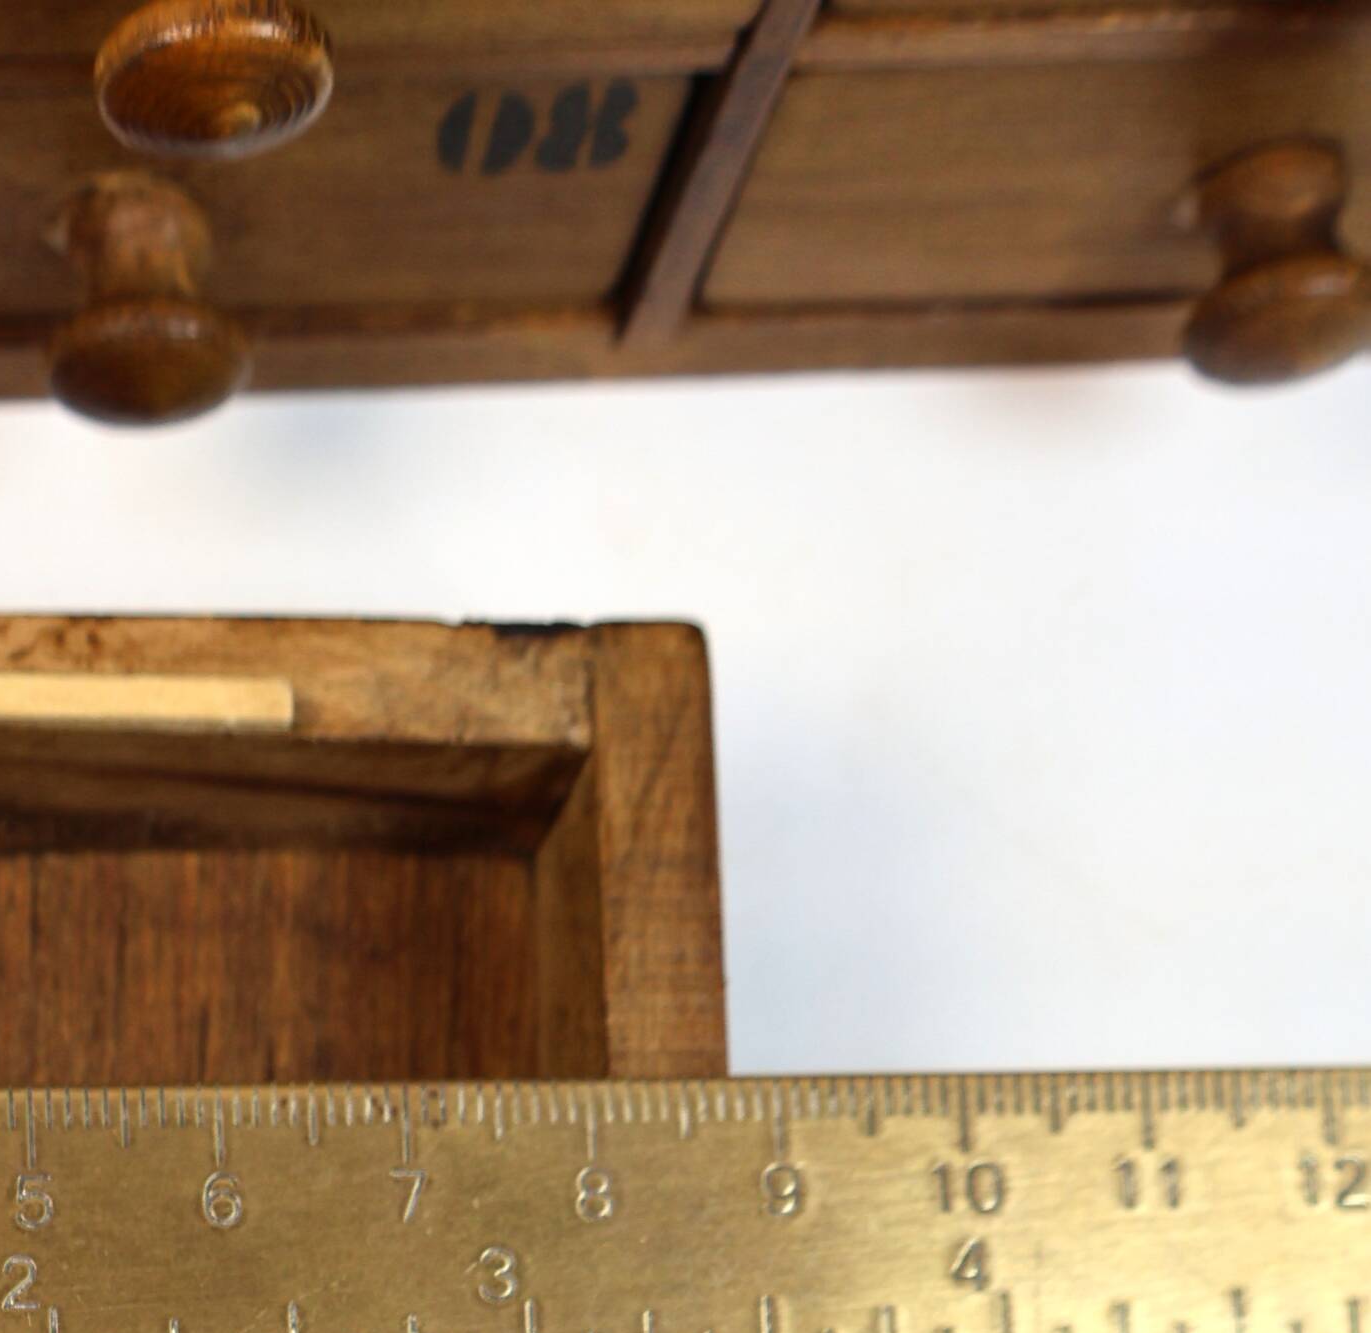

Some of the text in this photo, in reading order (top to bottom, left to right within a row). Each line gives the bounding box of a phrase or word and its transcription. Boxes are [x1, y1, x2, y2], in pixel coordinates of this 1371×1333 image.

[435, 77, 639, 176] 08
[15, 1172, 54, 1229] 5
[201, 1170, 243, 1228] 6
[389, 1168, 425, 1224] 7
[575, 1165, 613, 1222] 8
[760, 1161, 801, 1217] 9
[932, 1160, 1008, 1215] 10
[1113, 1156, 1181, 1210] 11
[1299, 1155, 1371, 1209] 12
[1, 1254, 39, 1312] 2
[478, 1246, 517, 1303] 3
[949, 1235, 990, 1292] 4
